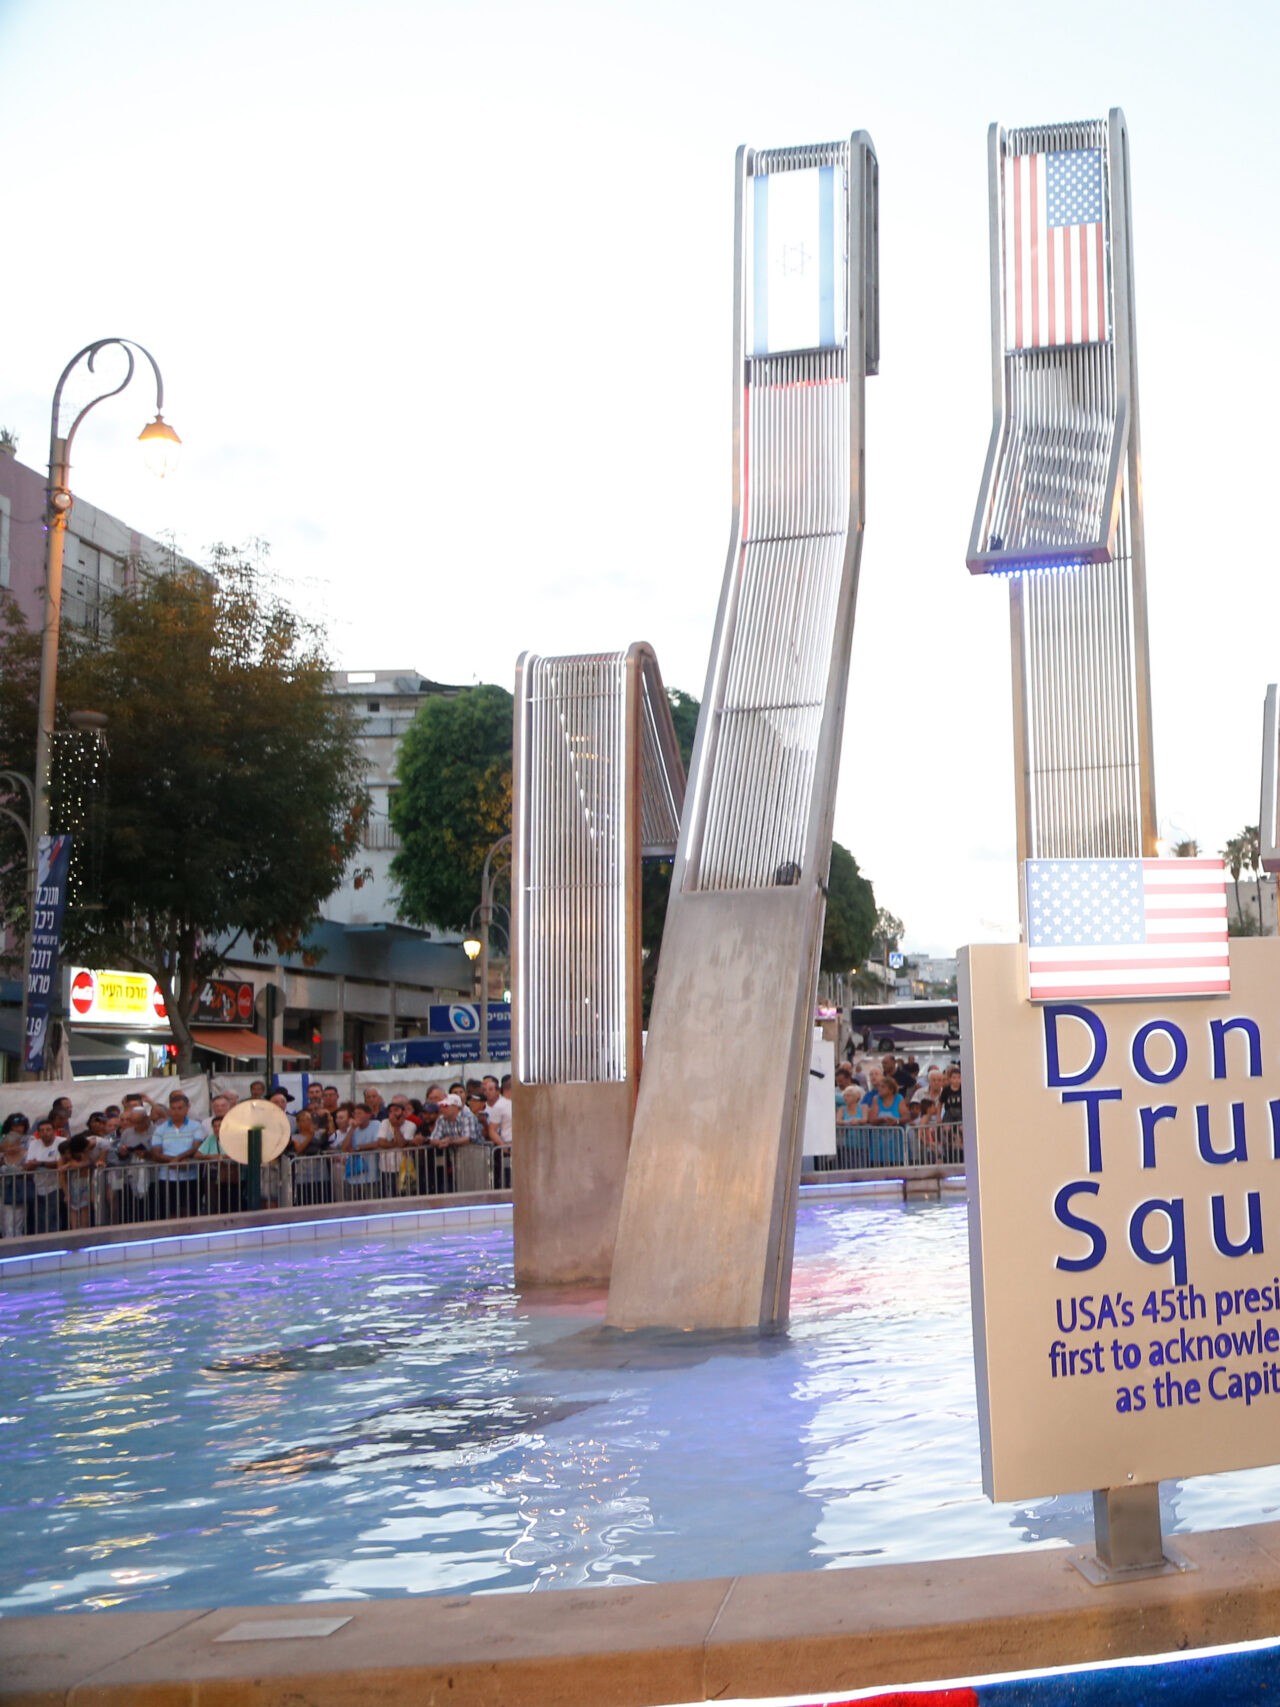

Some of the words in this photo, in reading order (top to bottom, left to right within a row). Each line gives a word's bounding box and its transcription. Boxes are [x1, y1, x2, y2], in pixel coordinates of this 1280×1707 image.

[31, 947, 52, 969] דונל
[101, 983, 122, 999] העיר
[125, 985, 147, 999] מרכז
[1057, 1294, 1134, 1333] USA's
[1142, 1285, 1206, 1322] 45th
[1050, 1342, 1104, 1376] first
[1111, 1340, 1141, 1370] to
[1116, 1385, 1146, 1413] as
[1154, 1372, 1200, 1408] the
